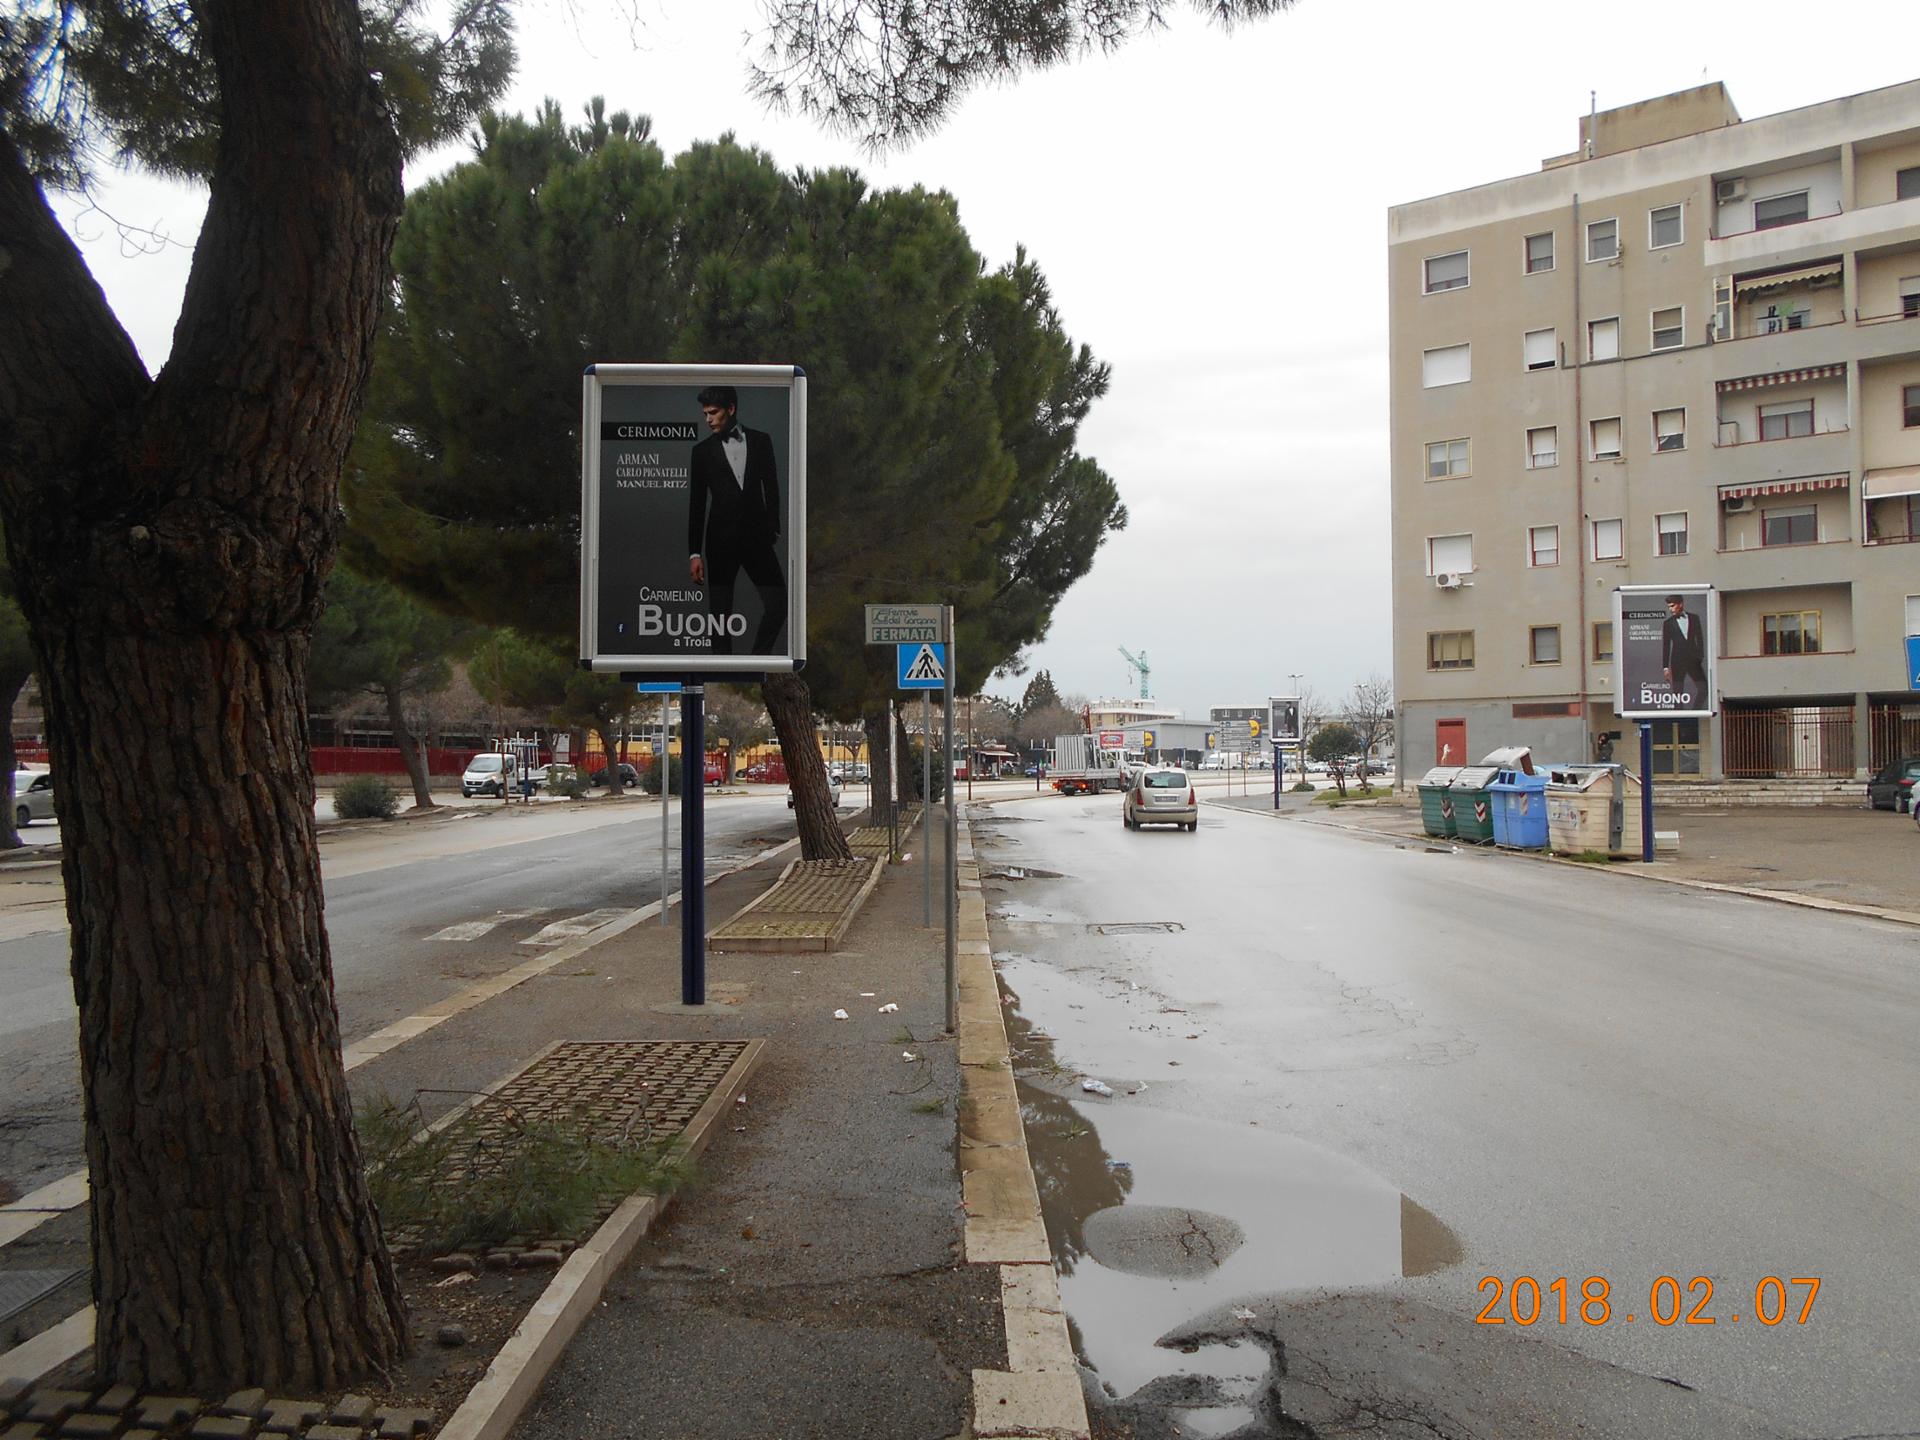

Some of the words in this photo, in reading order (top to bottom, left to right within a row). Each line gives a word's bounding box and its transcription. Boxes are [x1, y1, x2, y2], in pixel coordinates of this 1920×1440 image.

[617, 426, 696, 438] CERIMONIA
[616, 453, 659, 465] ARMANI
[616, 467, 642, 477] CARLO
[643, 467, 688, 478] PIGNATELLI
[616, 480, 662, 488] MANUEL
[663, 480, 688, 488] RITZ
[873, 628, 935, 640] FERMATA
[673, 638, 681, 647] a
[683, 636, 712, 647] Troia
